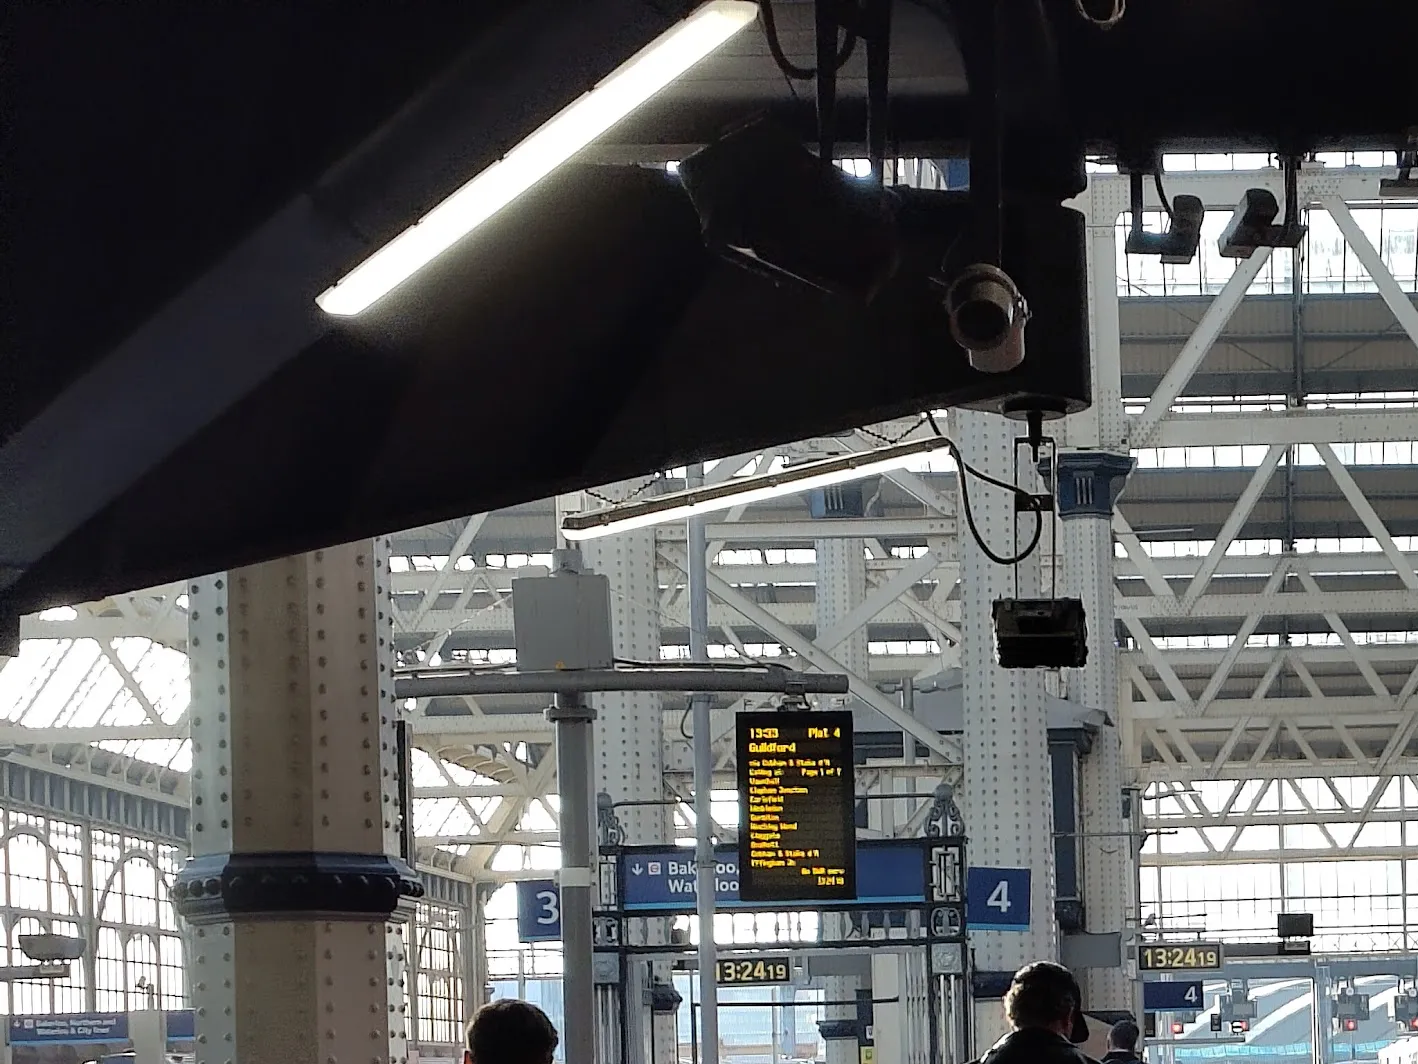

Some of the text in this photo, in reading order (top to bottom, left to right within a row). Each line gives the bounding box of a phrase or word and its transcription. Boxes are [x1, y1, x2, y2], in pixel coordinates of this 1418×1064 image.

[833, 727, 841, 738] 4
[749, 742, 796, 753] Guildford
[801, 768, 818, 777] Page
[826, 768, 834, 776] of
[749, 777, 780, 785] Vauxhall
[749, 786, 808, 795] Clapham Junction
[749, 795, 784, 804] Earlsfield
[668, 861, 739, 877] Bakoo,
[668, 877, 739, 893] Watloo
[987, 880, 1012, 912] 4
[536, 891, 560, 925] 3
[1184, 986, 1198, 1003] 4
[103, 1017, 117, 1026] and
[77, 1026, 92, 1035] City
